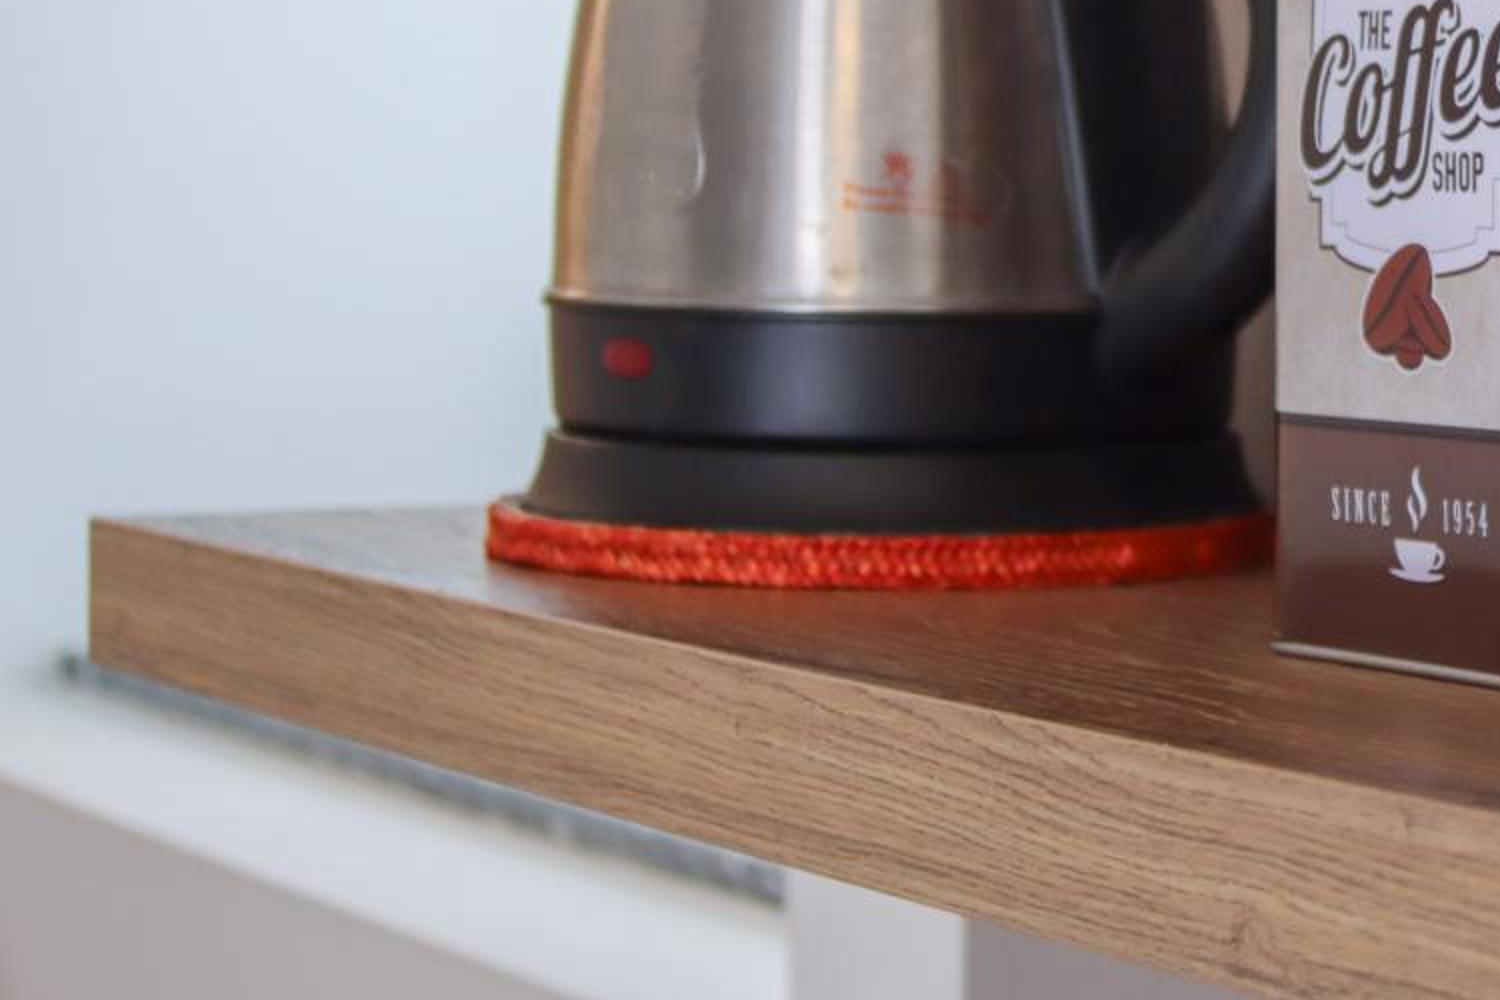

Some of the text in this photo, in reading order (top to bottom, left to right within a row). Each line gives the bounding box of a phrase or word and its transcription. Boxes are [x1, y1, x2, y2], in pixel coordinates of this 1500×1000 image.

[1358, 10, 1393, 51] THE
[1432, 152, 1484, 193] SHOP
[1330, 486, 1490, 538] SINCE 1954
